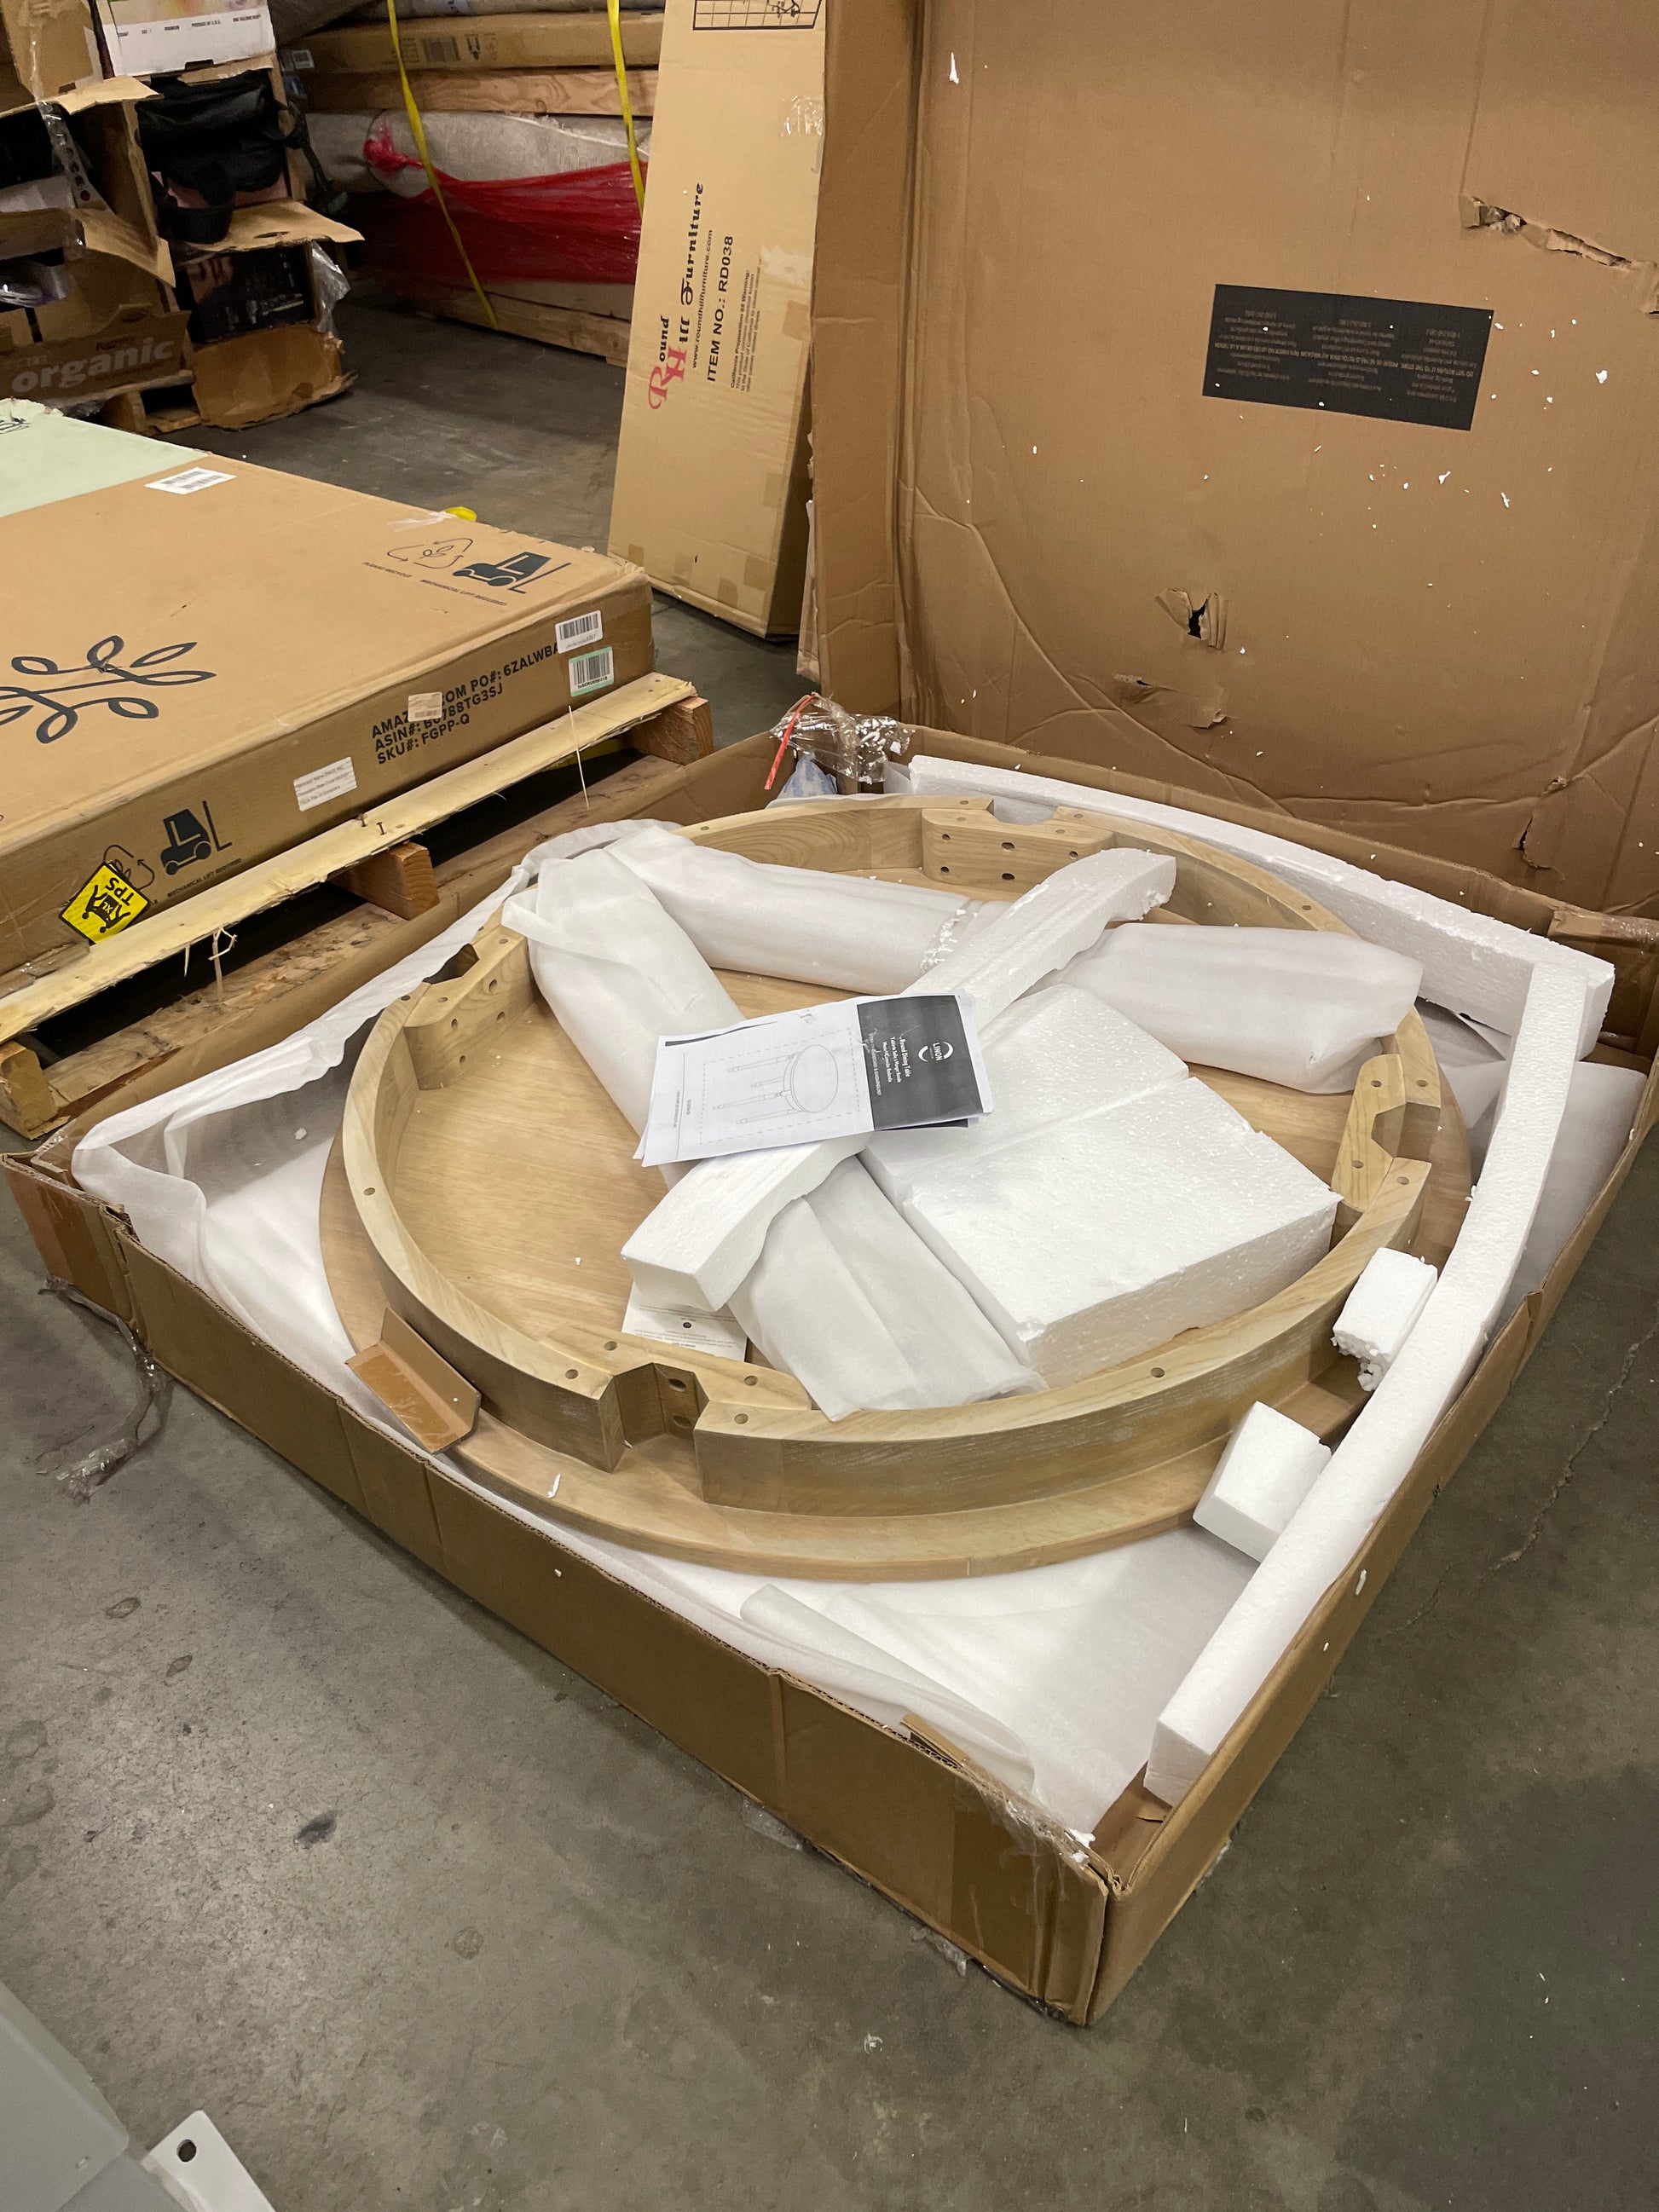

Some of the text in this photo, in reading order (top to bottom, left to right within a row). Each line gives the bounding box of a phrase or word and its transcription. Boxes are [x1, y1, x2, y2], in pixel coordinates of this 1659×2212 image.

[679, 182, 705, 306] Furniture
[707, 234, 734, 382] ITEM NO.: RD038
[11, 337, 174, 393] organic
[471, 670, 502, 691] PO#:
[375, 723, 421, 752] ASIN#:
[378, 713, 470, 764] SKU#: FGPP-Q
[105, 877, 134, 906] TPS
[103, 901, 113, 912] XL
[933, 1042, 943, 1061] LINON
